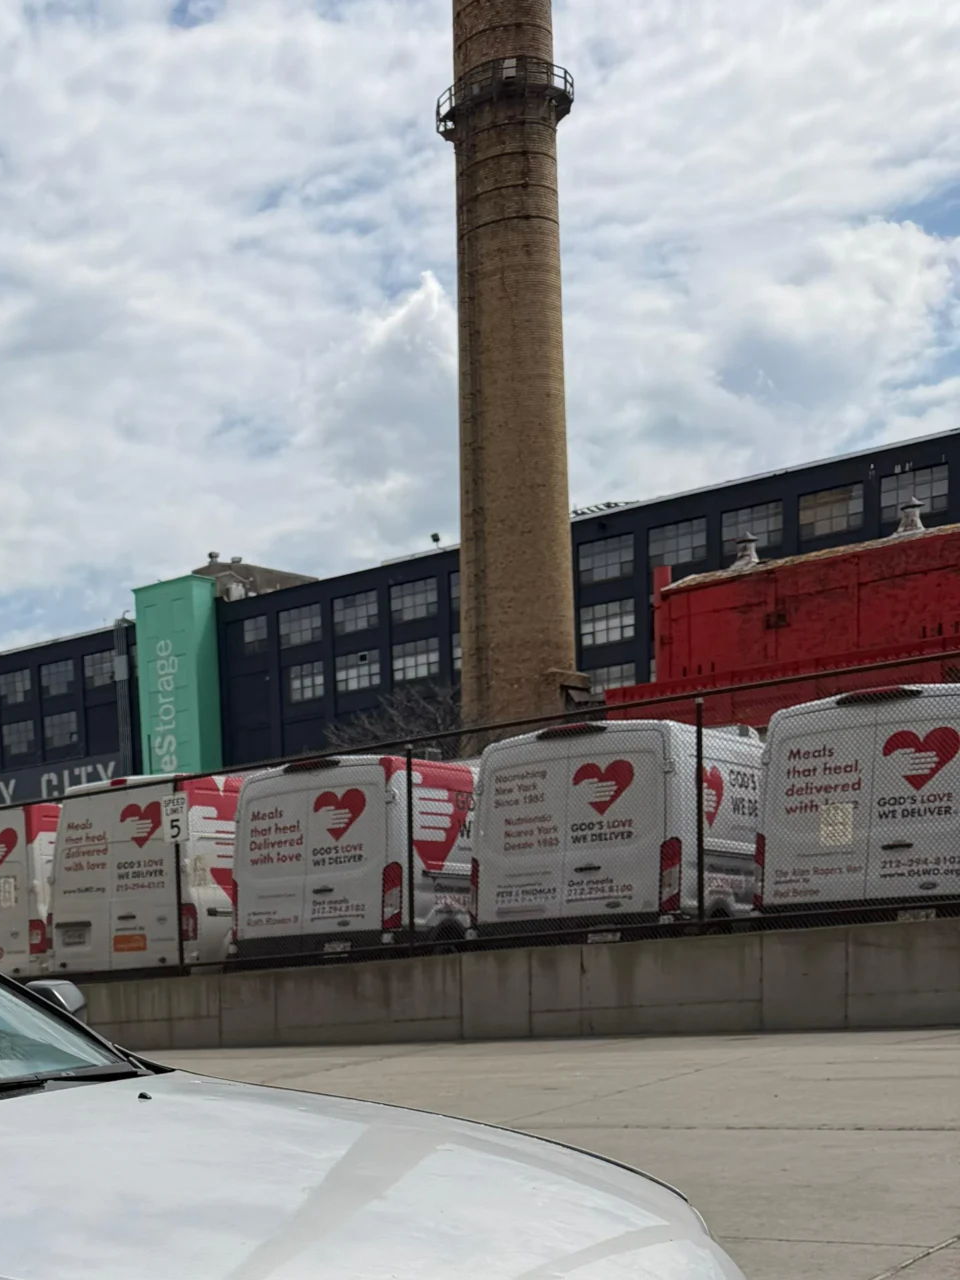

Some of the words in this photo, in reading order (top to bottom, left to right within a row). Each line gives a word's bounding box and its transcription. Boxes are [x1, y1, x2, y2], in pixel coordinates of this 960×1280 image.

[788, 745, 834, 761] Meals
[41, 761, 116, 799] CITY
[787, 767, 818, 779] that
[785, 777, 862, 797] delivered
[163, 797, 186, 808] SPEED
[877, 795, 917, 807] GOD'S
[920, 792, 953, 804] LOVE
[165, 806, 184, 816] LIMIT
[785, 800, 819, 815] with
[878, 809, 897, 820] WE
[251, 808, 284, 822] Meals
[66, 819, 92, 831] Meals
[170, 818, 182, 839] 5
[251, 824, 272, 838] that
[571, 820, 604, 833] GOD'S
[607, 819, 633, 829] LOVE
[249, 834, 304, 851] Delivered
[571, 833, 588, 844] WE
[64, 846, 108, 860] delivered
[312, 846, 339, 857] GOD'S
[341, 843, 364, 854] LOVE
[143, 859, 164, 868] LOVE
[250, 852, 274, 866] with
[276, 851, 302, 863] love
[312, 857, 326, 867] WE
[64, 863, 84, 873] with
[86, 860, 107, 870] love
[116, 871, 130, 880] WE
